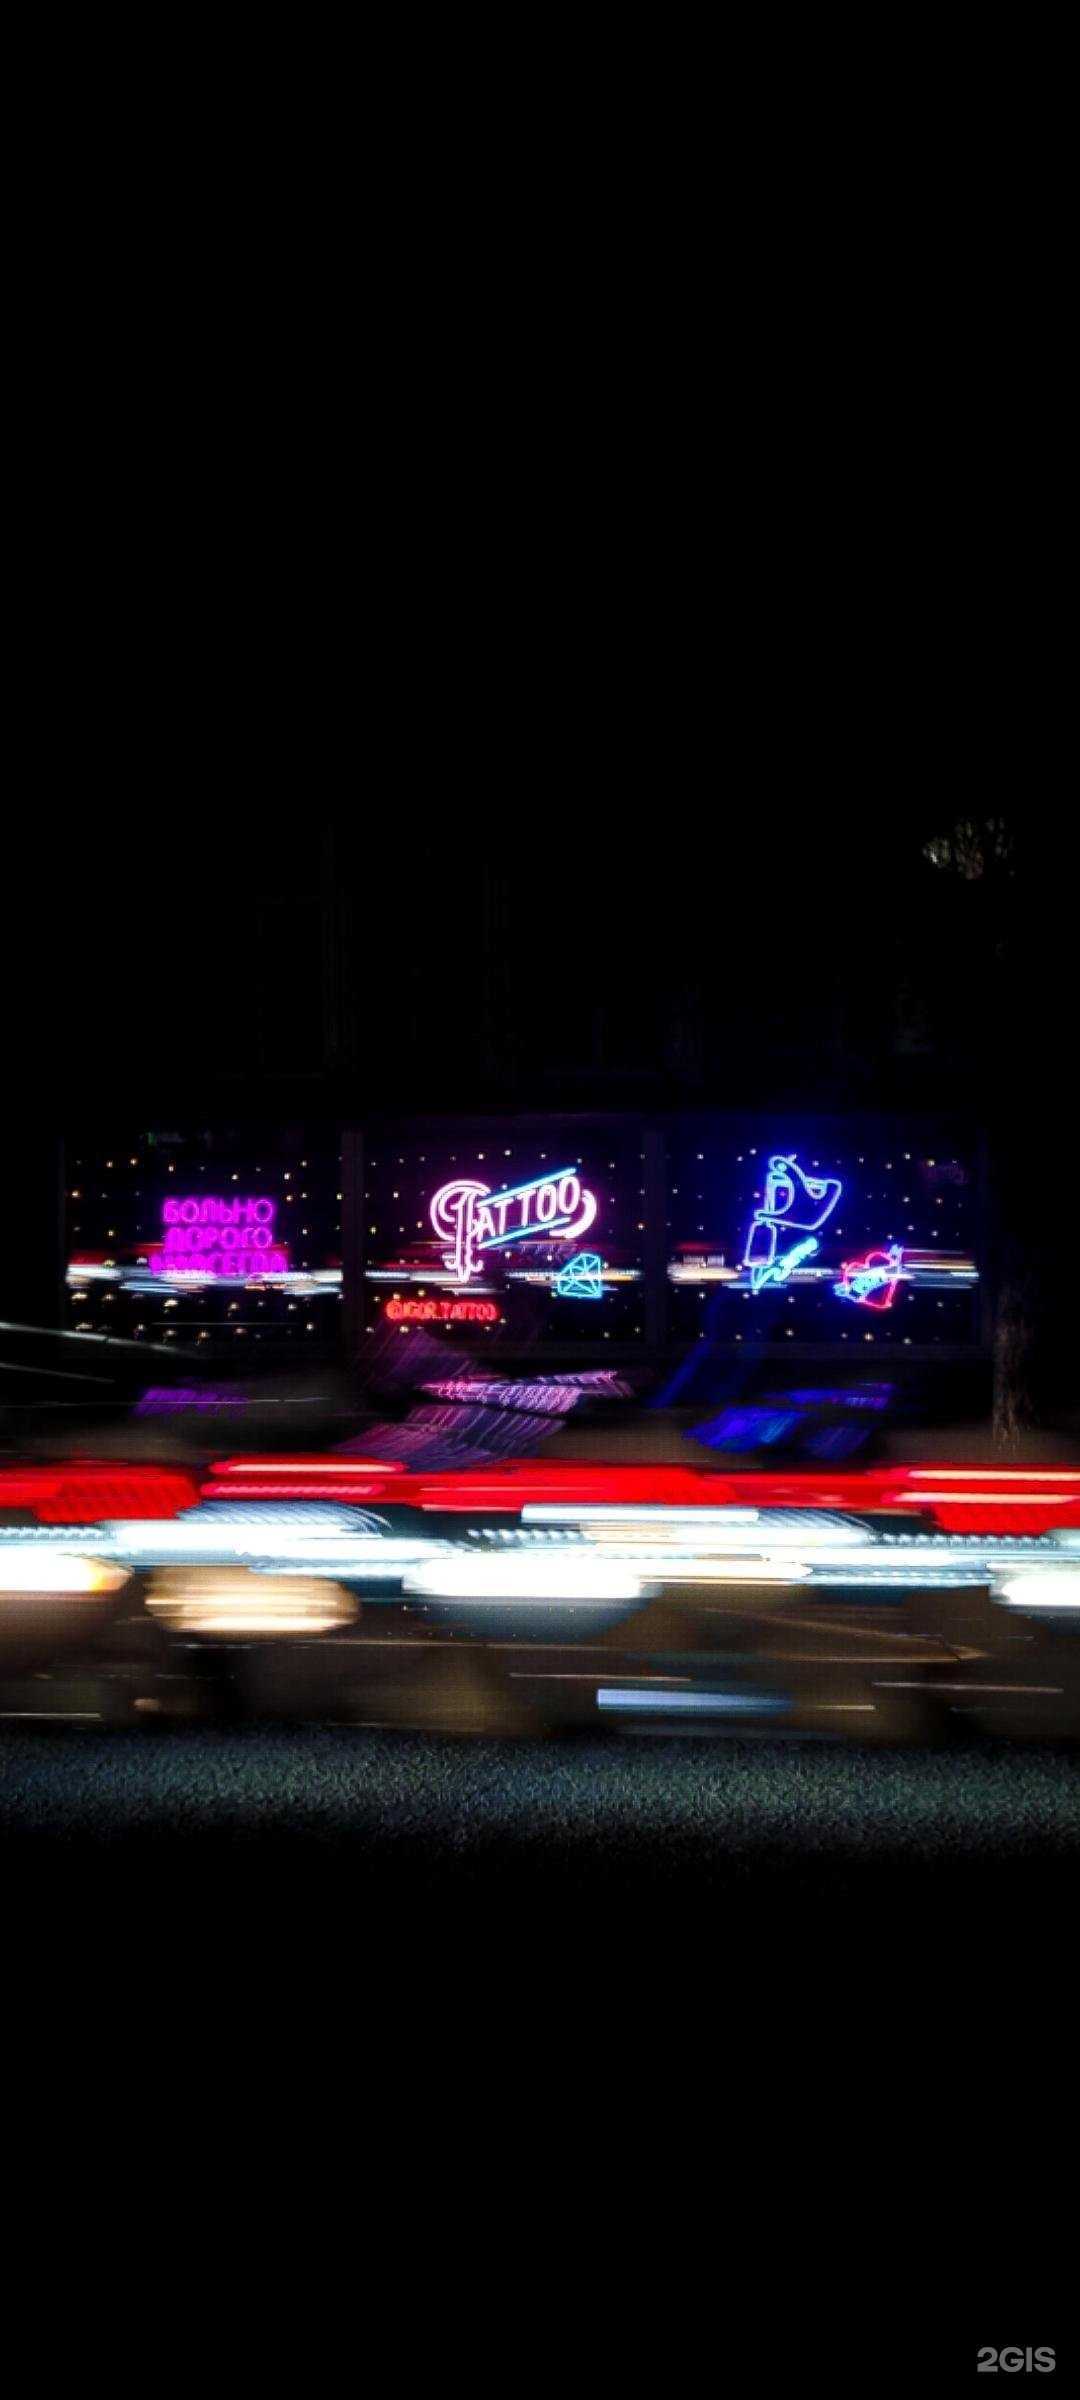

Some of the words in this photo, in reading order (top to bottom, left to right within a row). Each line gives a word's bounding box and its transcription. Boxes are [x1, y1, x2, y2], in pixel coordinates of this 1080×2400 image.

[163, 1197, 274, 1223] БОЛЬНО
[164, 1227, 273, 1252] ДОРОГО
[430, 1176, 597, 1283] TATTOO
